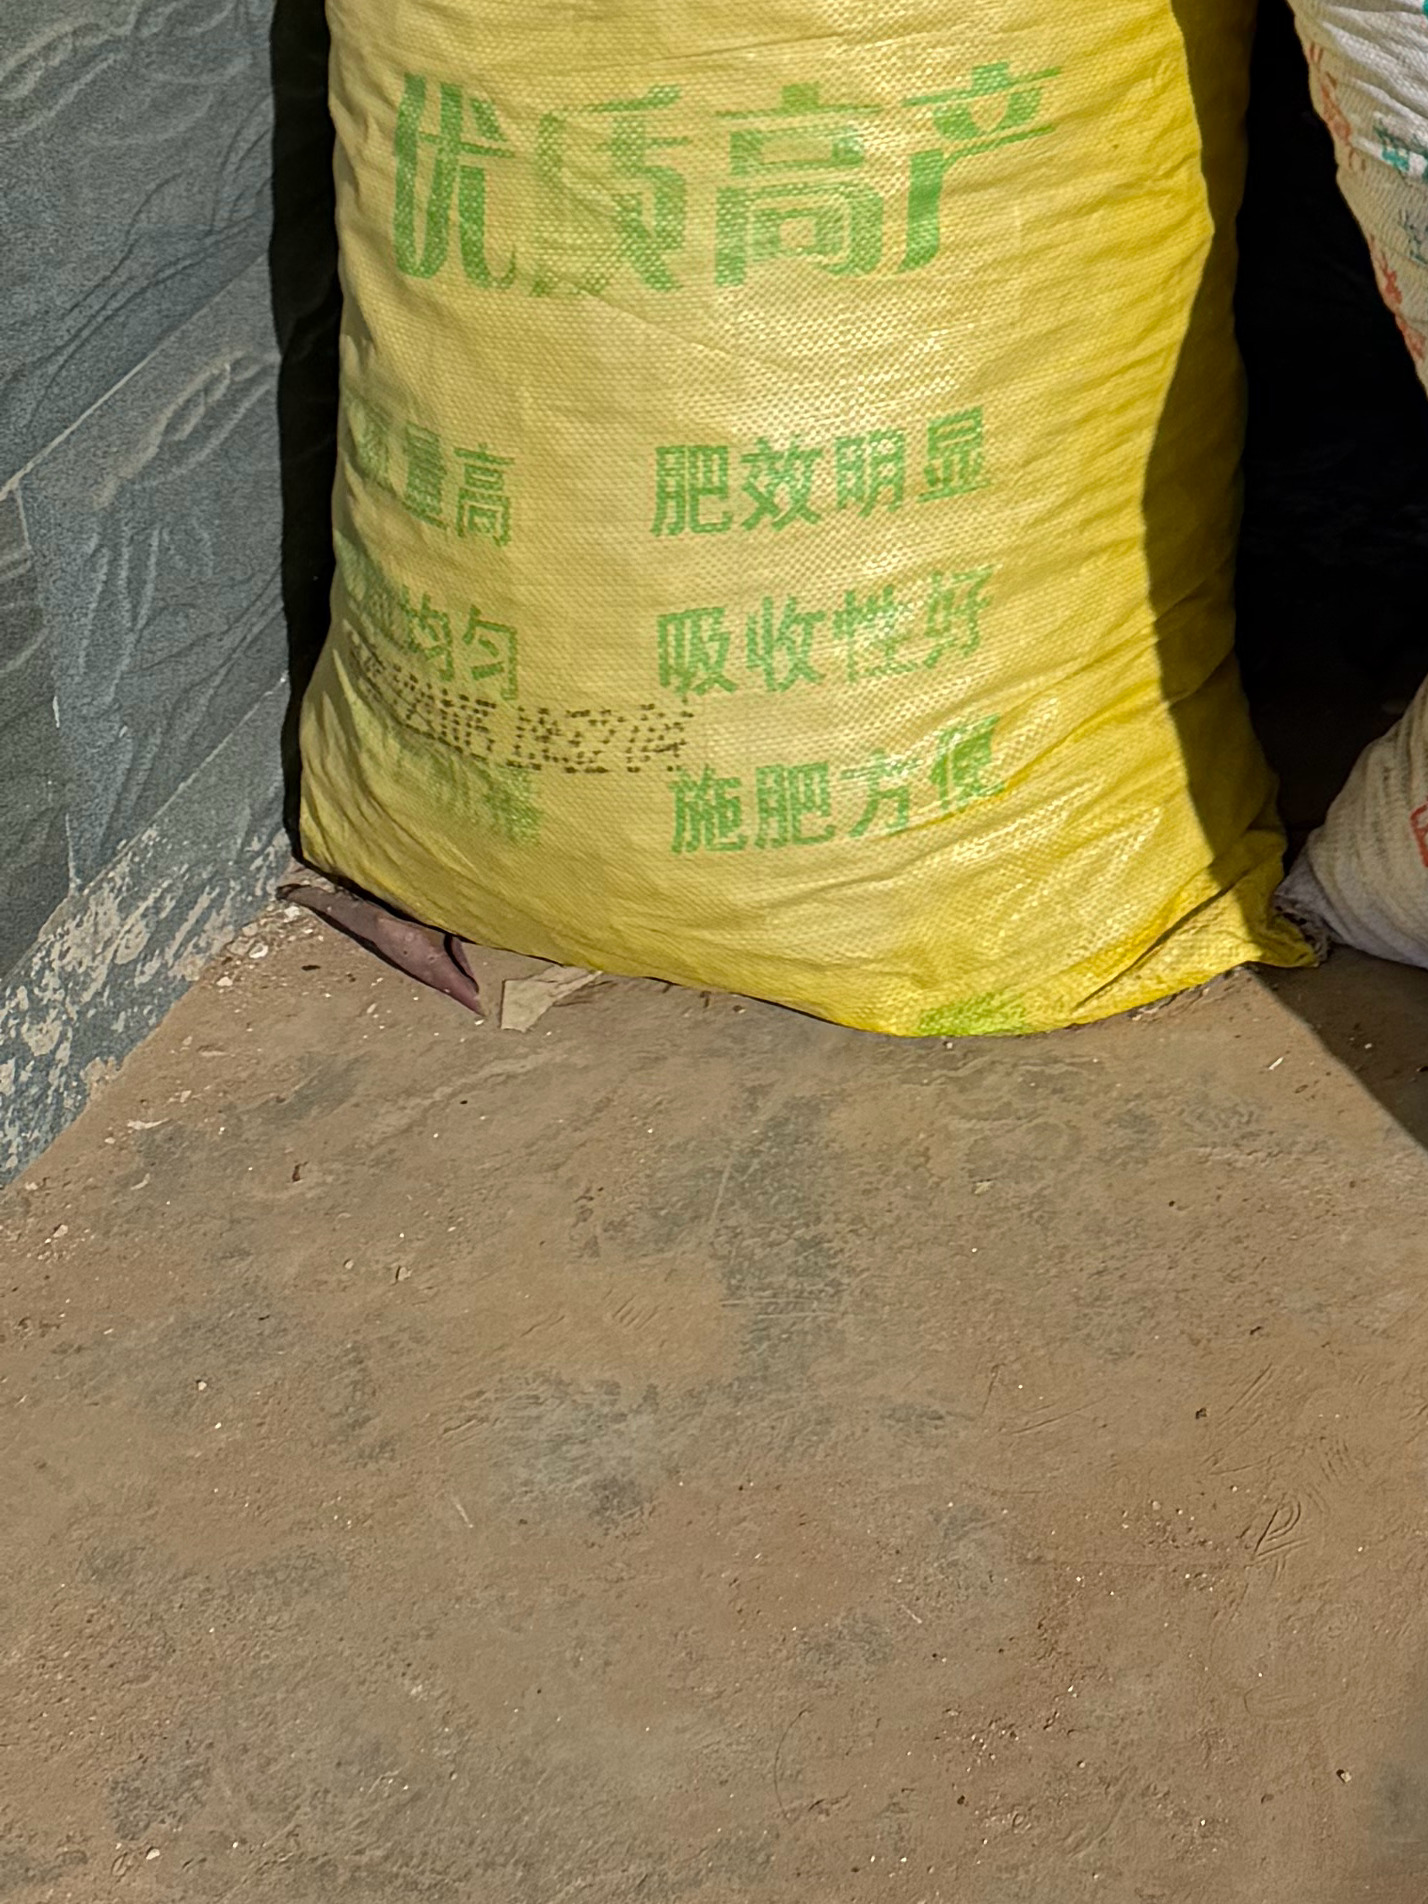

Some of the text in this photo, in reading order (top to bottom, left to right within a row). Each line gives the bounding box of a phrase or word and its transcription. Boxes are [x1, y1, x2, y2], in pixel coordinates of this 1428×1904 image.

[393, 60, 1062, 296] 优质高产
[650, 405, 992, 537] 肥效明显
[656, 563, 1000, 697] 吸收性好
[669, 713, 1006, 854] 施肥方便
